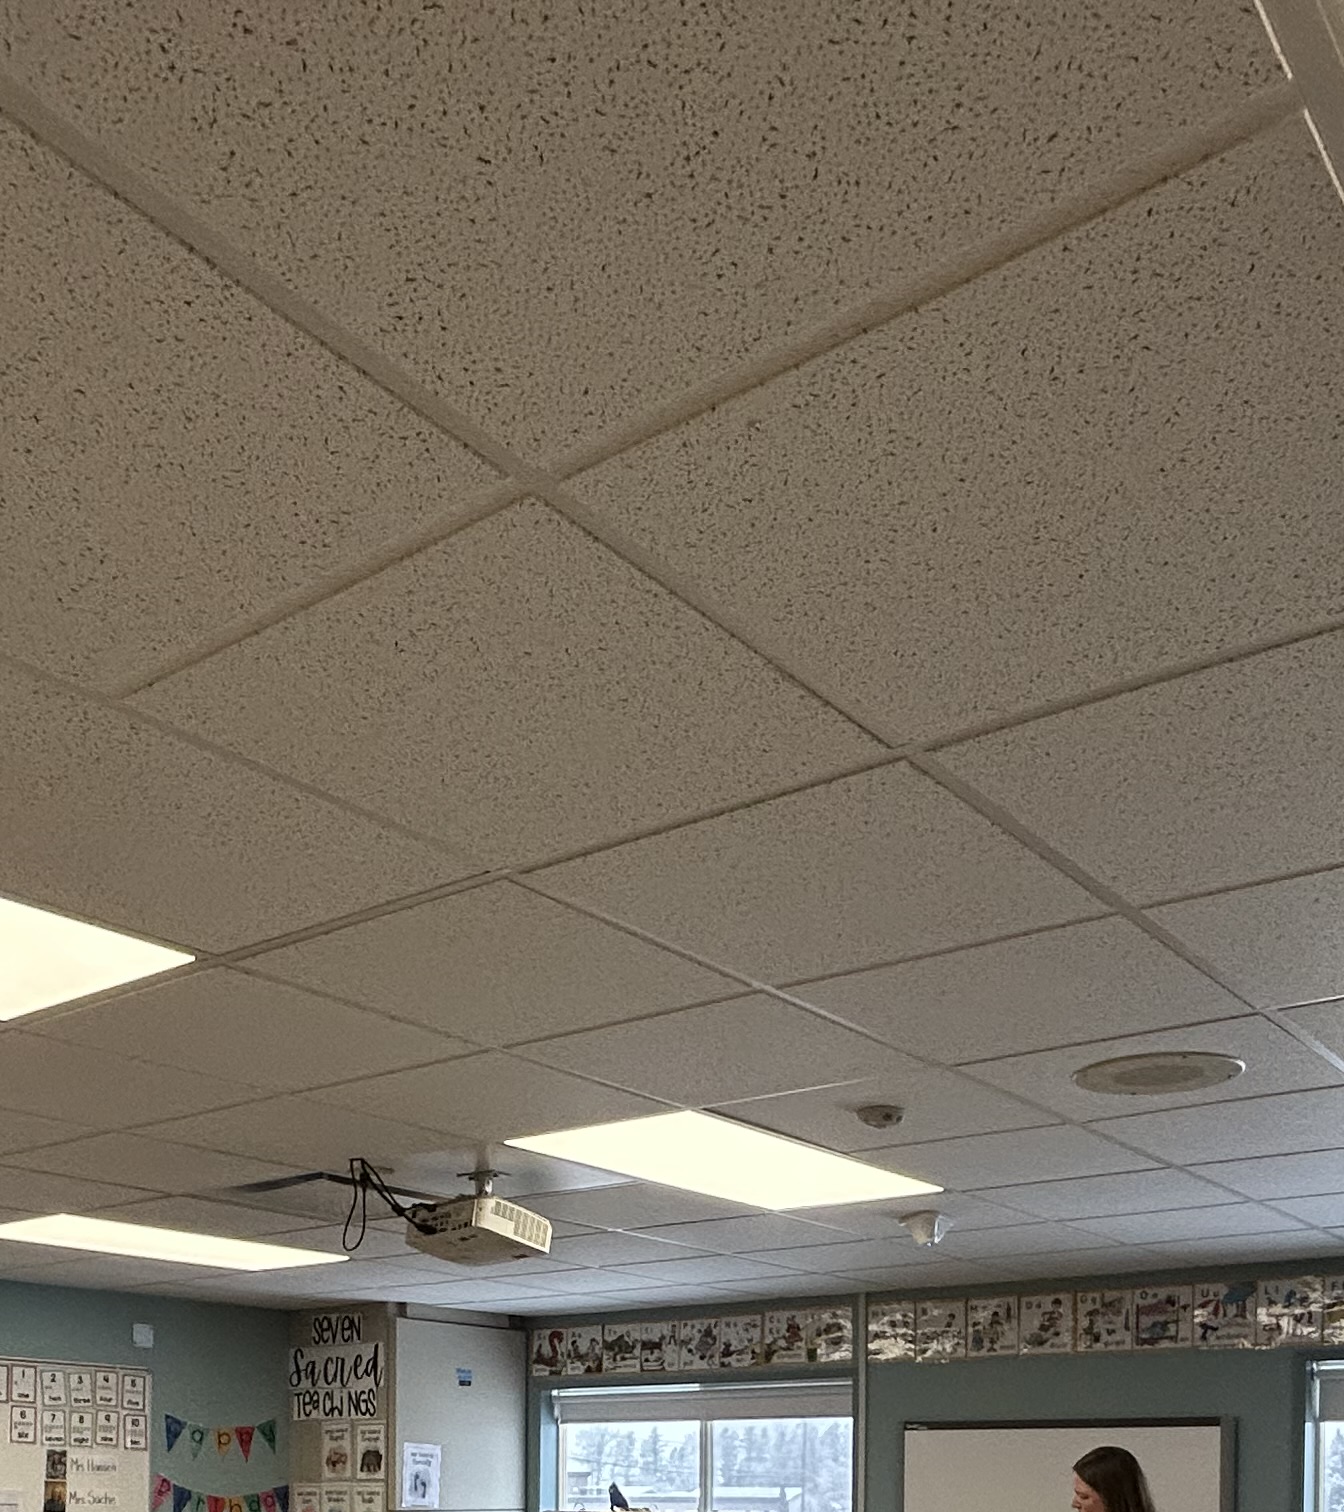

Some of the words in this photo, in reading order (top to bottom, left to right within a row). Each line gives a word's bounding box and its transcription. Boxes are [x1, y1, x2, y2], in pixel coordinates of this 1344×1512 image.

[289, 1343, 383, 1388] Sacred
[21, 1369, 26, 1379] 1
[50, 1373, 57, 1383] 2
[103, 1374, 110, 1384] 4
[77, 1376, 84, 1385] 3
[130, 1378, 137, 1388] 5
[20, 1410, 27, 1419] 6
[50, 1413, 56, 1423] 7
[78, 1414, 85, 1424] 8
[104, 1414, 111, 1423] 9
[131, 1418, 140, 1427] 10
